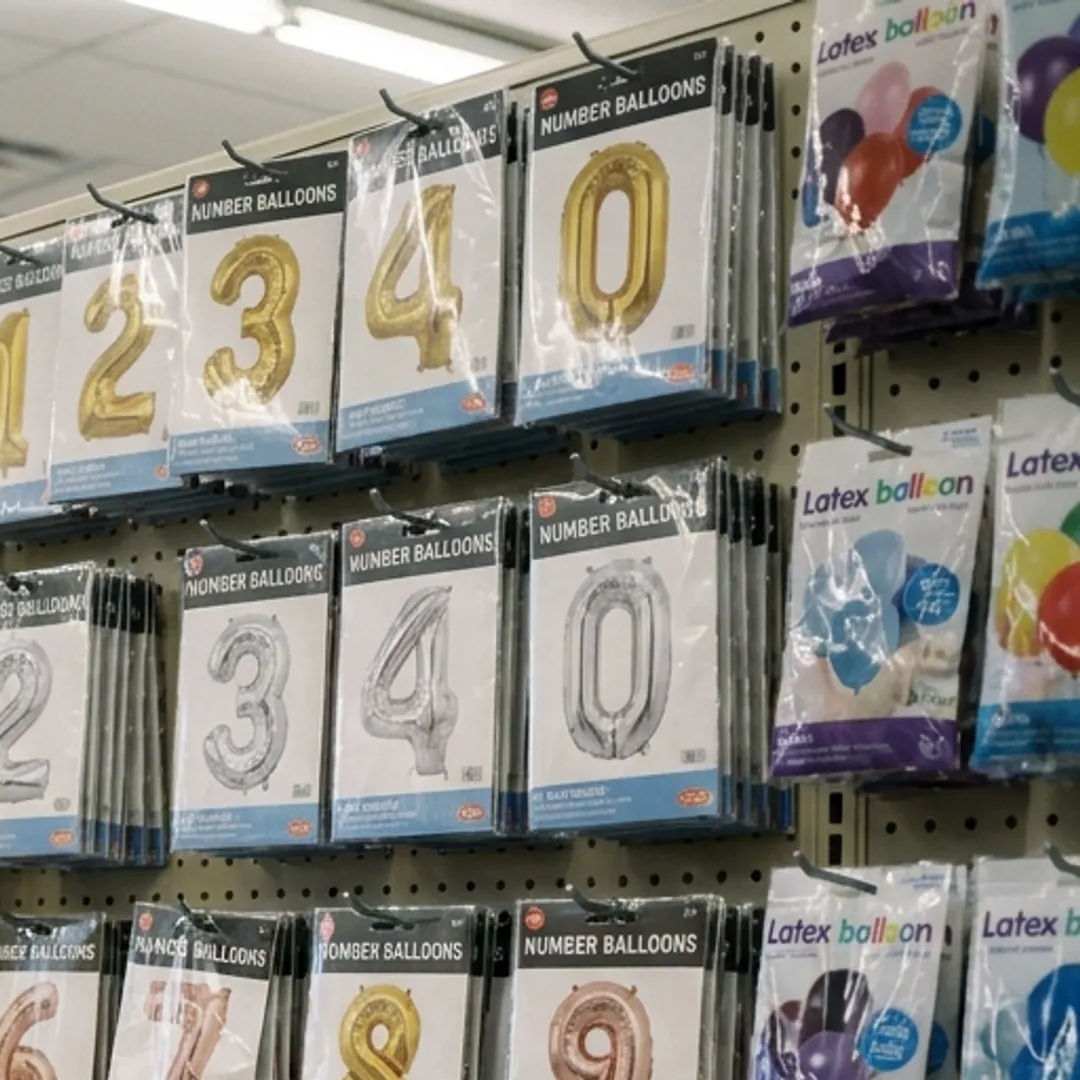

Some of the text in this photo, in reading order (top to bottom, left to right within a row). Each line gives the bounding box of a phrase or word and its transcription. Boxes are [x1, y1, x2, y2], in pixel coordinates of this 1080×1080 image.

[540, 75, 707, 136] NUMBER BALLOONS
[257, 184, 337, 212] BALLOONS
[559, 142, 669, 342] 0
[365, 184, 462, 371] 4
[204, 234, 301, 406] 3
[79, 273, 156, 441] 2
[540, 514, 610, 545] NUMBER
[803, 486, 869, 516] Latex
[414, 532, 494, 563] BALLOONS
[361, 585, 458, 779] 4
[563, 558, 672, 760] 0
[203, 613, 290, 793] 3
[603, 934, 698, 956] BALLOONS
[767, 918, 831, 945] Latex
[983, 909, 1058, 938] Latex
